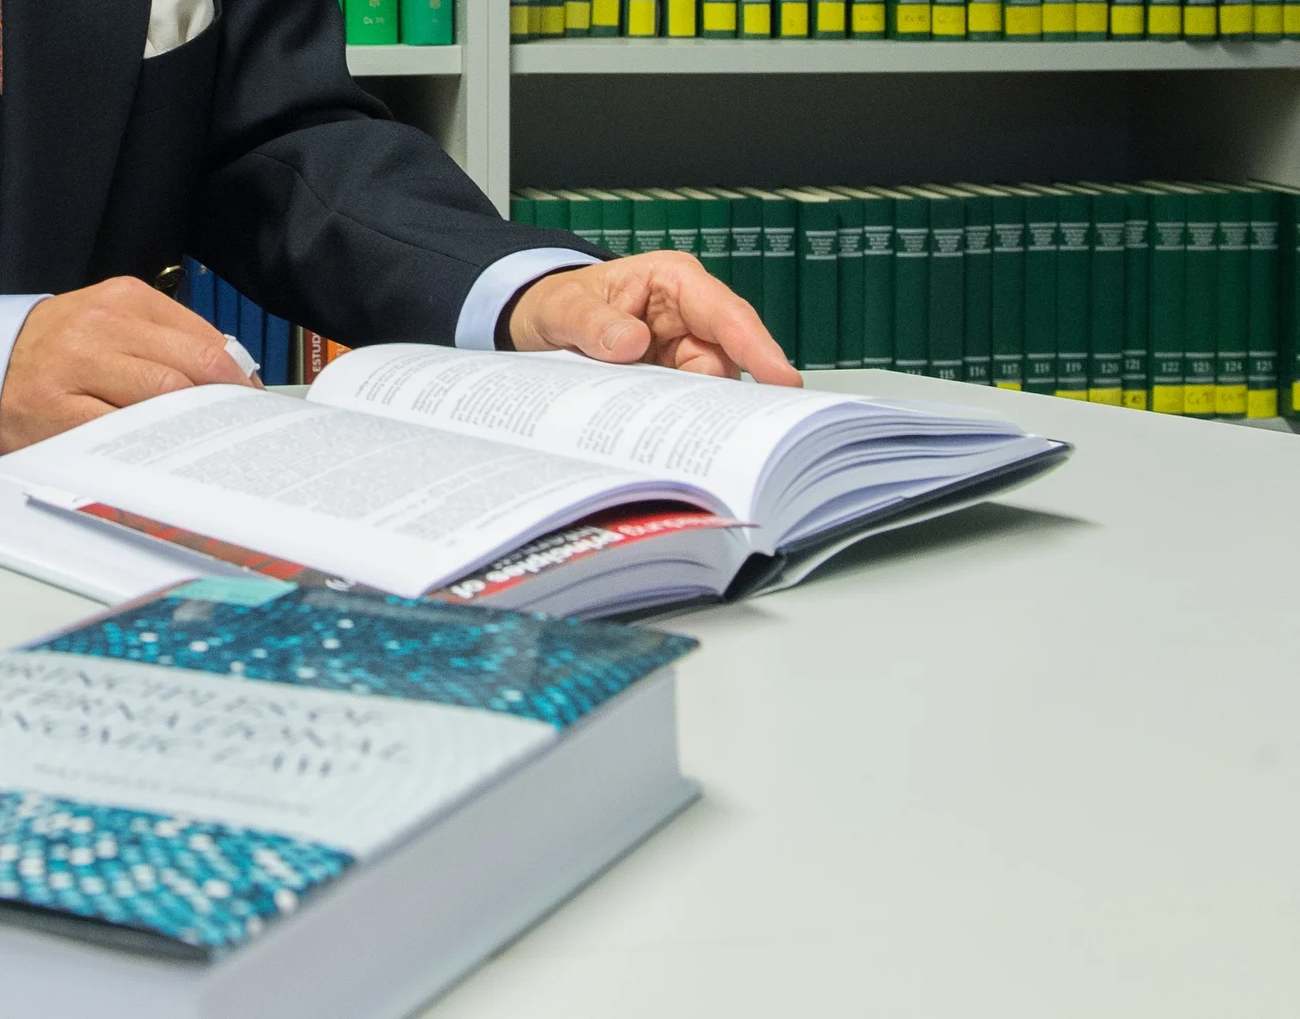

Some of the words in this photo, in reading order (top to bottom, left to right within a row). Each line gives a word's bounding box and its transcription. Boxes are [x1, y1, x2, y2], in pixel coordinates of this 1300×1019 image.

[311, 332, 322, 372] ESTUD
[1002, 364, 1018, 374] 117
[1034, 363, 1050, 373] 118
[1065, 362, 1081, 372] 119
[1101, 363, 1118, 374] 120
[1125, 359, 1140, 370] 121
[1161, 362, 1179, 372] 122
[1224, 361, 1242, 372] 124
[969, 366, 985, 377] 116
